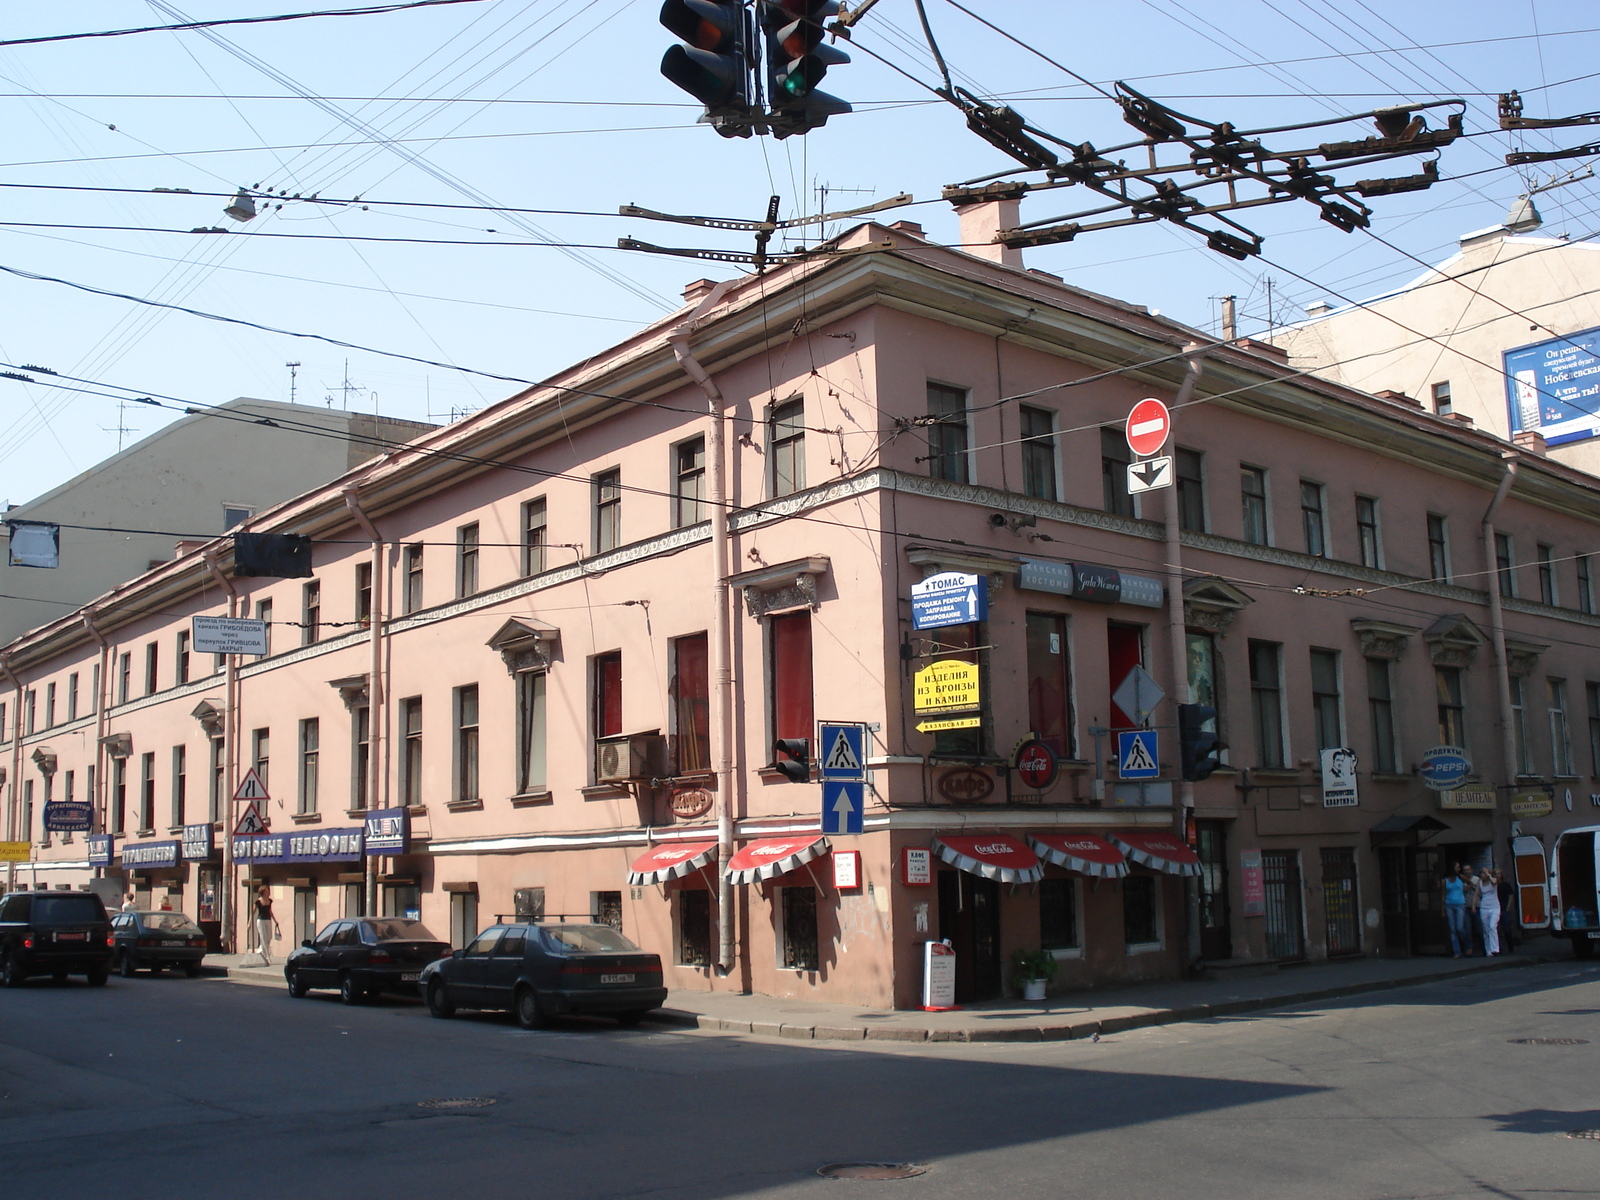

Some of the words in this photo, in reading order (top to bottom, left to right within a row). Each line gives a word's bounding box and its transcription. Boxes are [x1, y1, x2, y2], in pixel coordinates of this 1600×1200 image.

[1546, 350, 1558, 359] Он
[1560, 344, 1587, 358] решил
[1578, 357, 1595, 368] будет
[1562, 386, 1578, 395] что
[1026, 562, 1069, 577] ЖЕНСКИЕ
[930, 576, 965, 590] ТОМАС
[1026, 575, 1069, 589] КОСТЮМЫ
[1120, 577, 1160, 590] ЖЕНСКАЯ
[913, 599, 942, 609] ПРОДАЖА
[942, 595, 966, 605] РЕМОНТ
[1120, 590, 1161, 602] ОДЕЖДА
[925, 604, 955, 615] ЗАПРАВКА
[919, 610, 961, 623] КОПИРОВАНИЕ
[924, 671, 968, 683] ИЗДЕЛИЯ
[917, 686, 930, 695] ИЗ
[935, 682, 976, 693] БРОНЗЫ
[935, 694, 968, 705] КАМНЯ
[924, 721, 965, 730] КАЗАНСКАЯ
[1424, 748, 1462, 757] ПРОДУКТЫ
[1435, 763, 1466, 772] PEPSI
[1455, 792, 1492, 806] ЦЕЛИТЕЛЬ
[183, 824, 208, 842] АВИА
[182, 841, 208, 859] КАССЫ
[232, 838, 283, 858] СОТОВЫЕ
[289, 834, 361, 856] ТЕЛЕФОНЫ
[121, 845, 176, 865] ТУРАГЕНТСТВО
